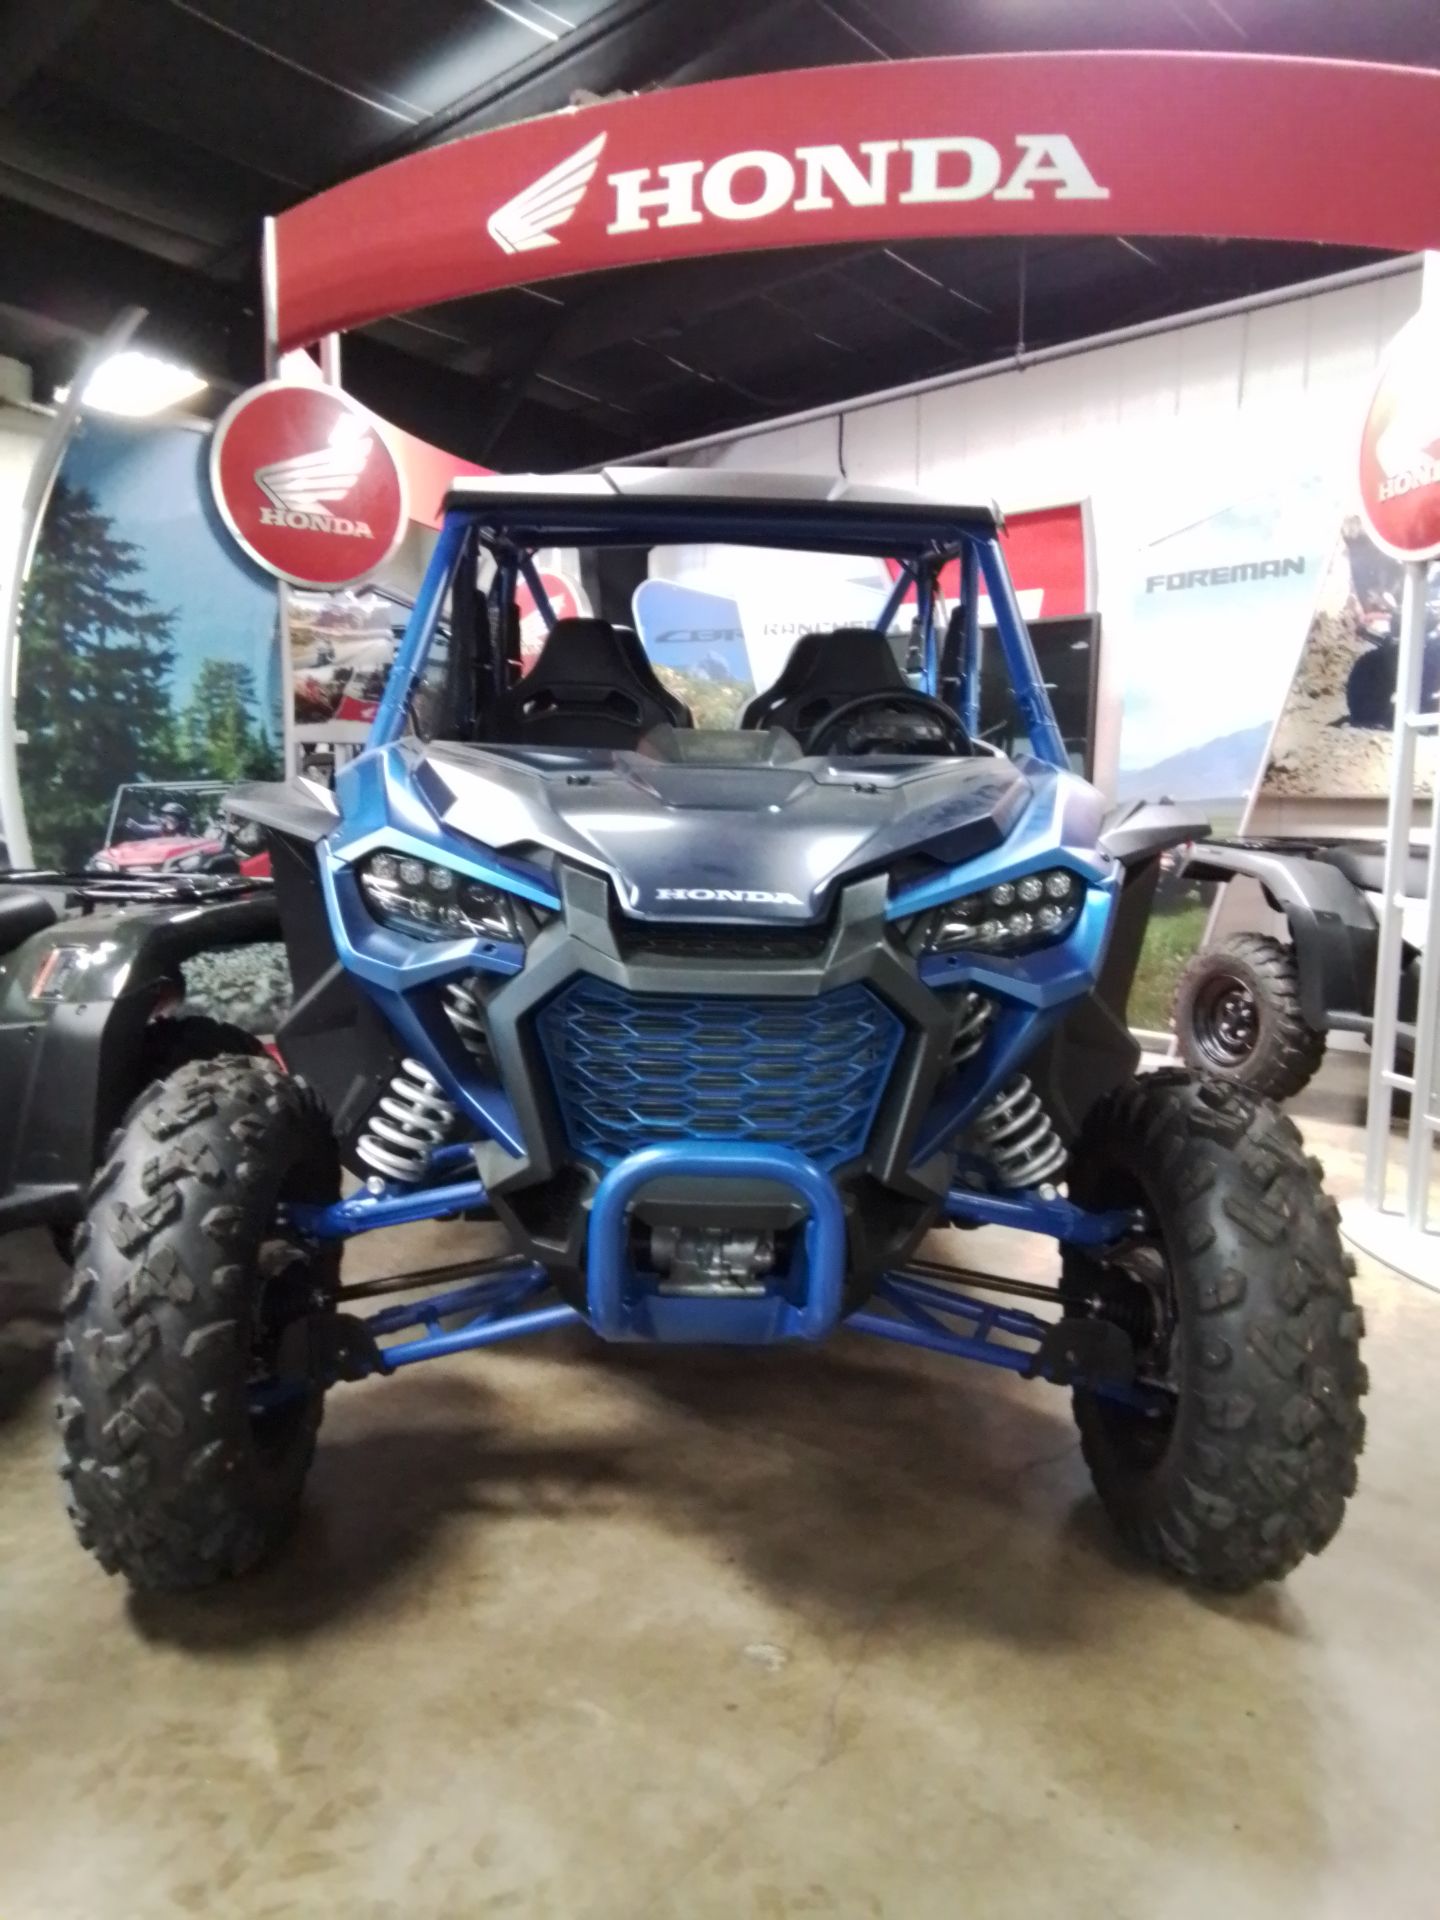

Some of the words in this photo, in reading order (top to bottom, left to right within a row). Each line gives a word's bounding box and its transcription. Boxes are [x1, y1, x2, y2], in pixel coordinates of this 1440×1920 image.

[606, 134, 1109, 234] HONDA
[259, 507, 375, 539] HONDA
[1145, 556, 1305, 594] FOREMAN
[655, 888, 805, 905] HONDA
